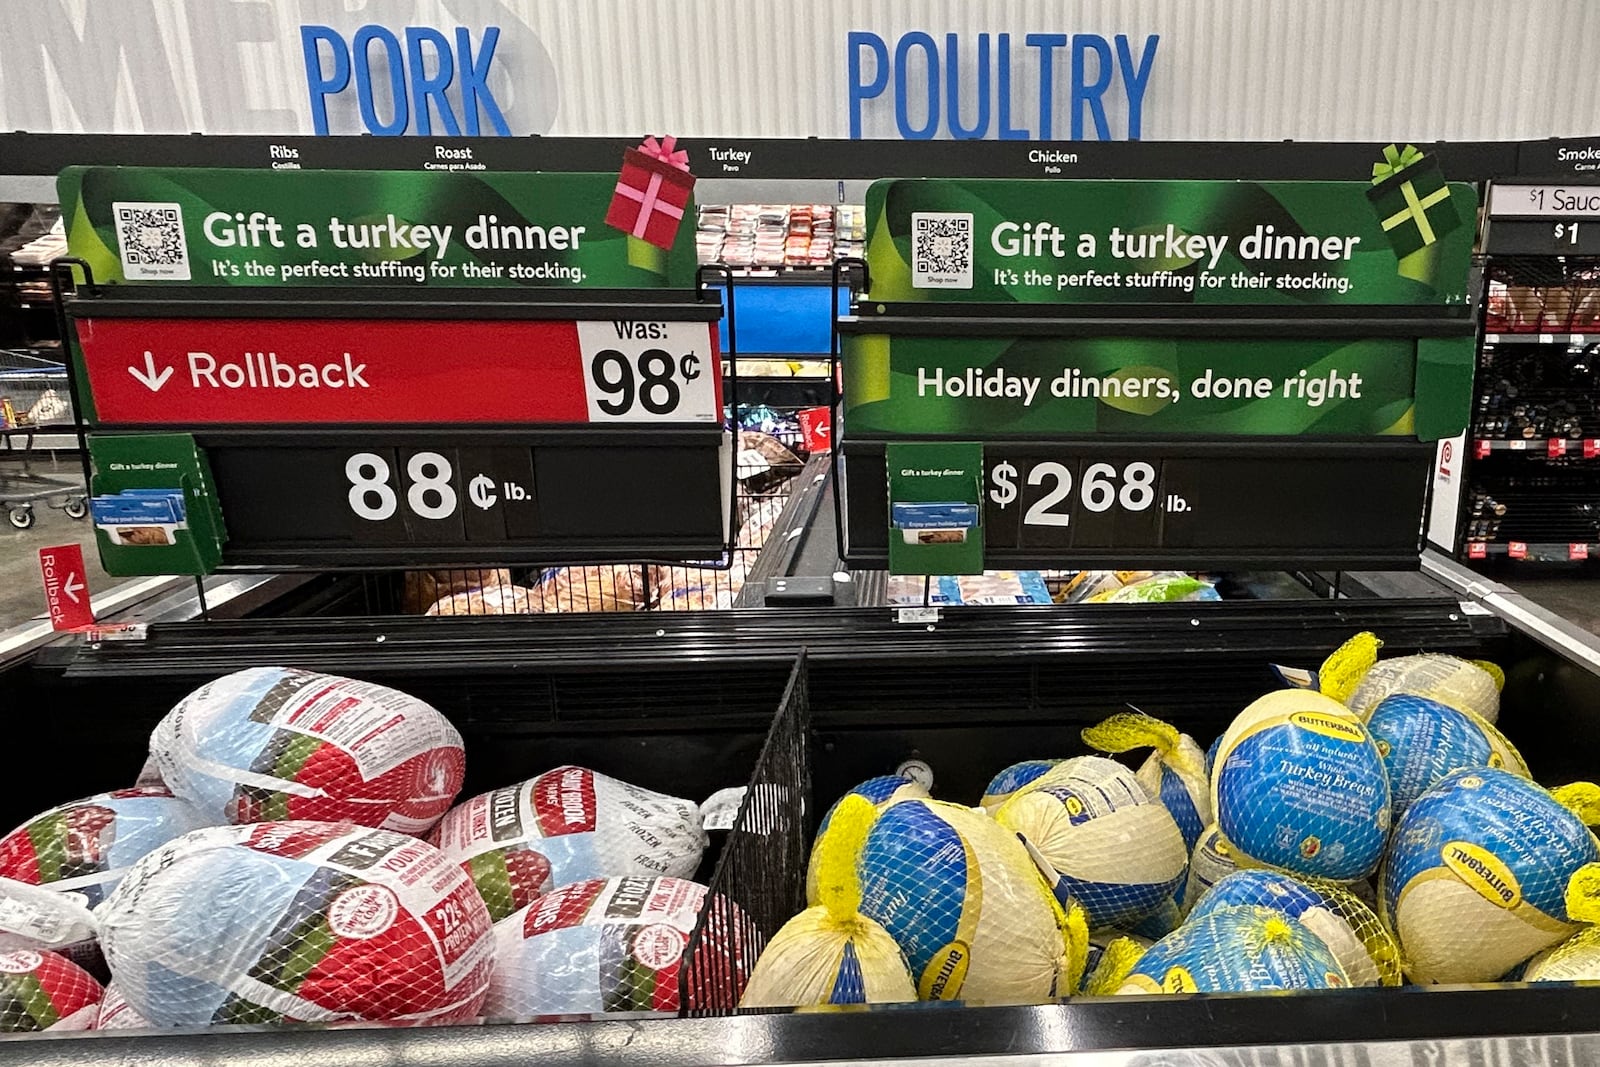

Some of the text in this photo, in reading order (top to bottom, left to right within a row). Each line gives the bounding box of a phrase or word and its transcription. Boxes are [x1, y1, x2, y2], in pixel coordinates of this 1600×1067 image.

[302, 26, 513, 137] PORK
[849, 32, 1159, 141] POULTRY
[270, 145, 298, 159] Ribs
[435, 146, 473, 160] Roast
[709, 148, 751, 164] Turkey
[1029, 150, 1077, 163] Chicken
[723, 164, 739, 172] Pavo
[1530, 189, 1544, 210] $1
[204, 212, 586, 259] Gift a turkey dinner
[1555, 222, 1579, 244] $1
[992, 222, 1361, 269] Gift a turkey dinner
[212, 260, 587, 284] It's the perfect stuffing for their stocking.
[995, 269, 1354, 294] It's the perfect stuffing for their stocking.
[614, 321, 668, 340] Was:
[188, 353, 369, 388] Rollback
[918, 368, 1363, 407] Holiday dinners, done right
[921, 469, 942, 477] turkey
[504, 482, 532, 501] lb.
[1166, 494, 1192, 512] lb.
[42, 554, 66, 625] Rollback
[1298, 716, 1361, 737] BUTTERBALL
[1281, 759, 1375, 797] Turkey Breast
[624, 819, 662, 849] FROZEN
[1450, 848, 1515, 902] BUTTERBALL
